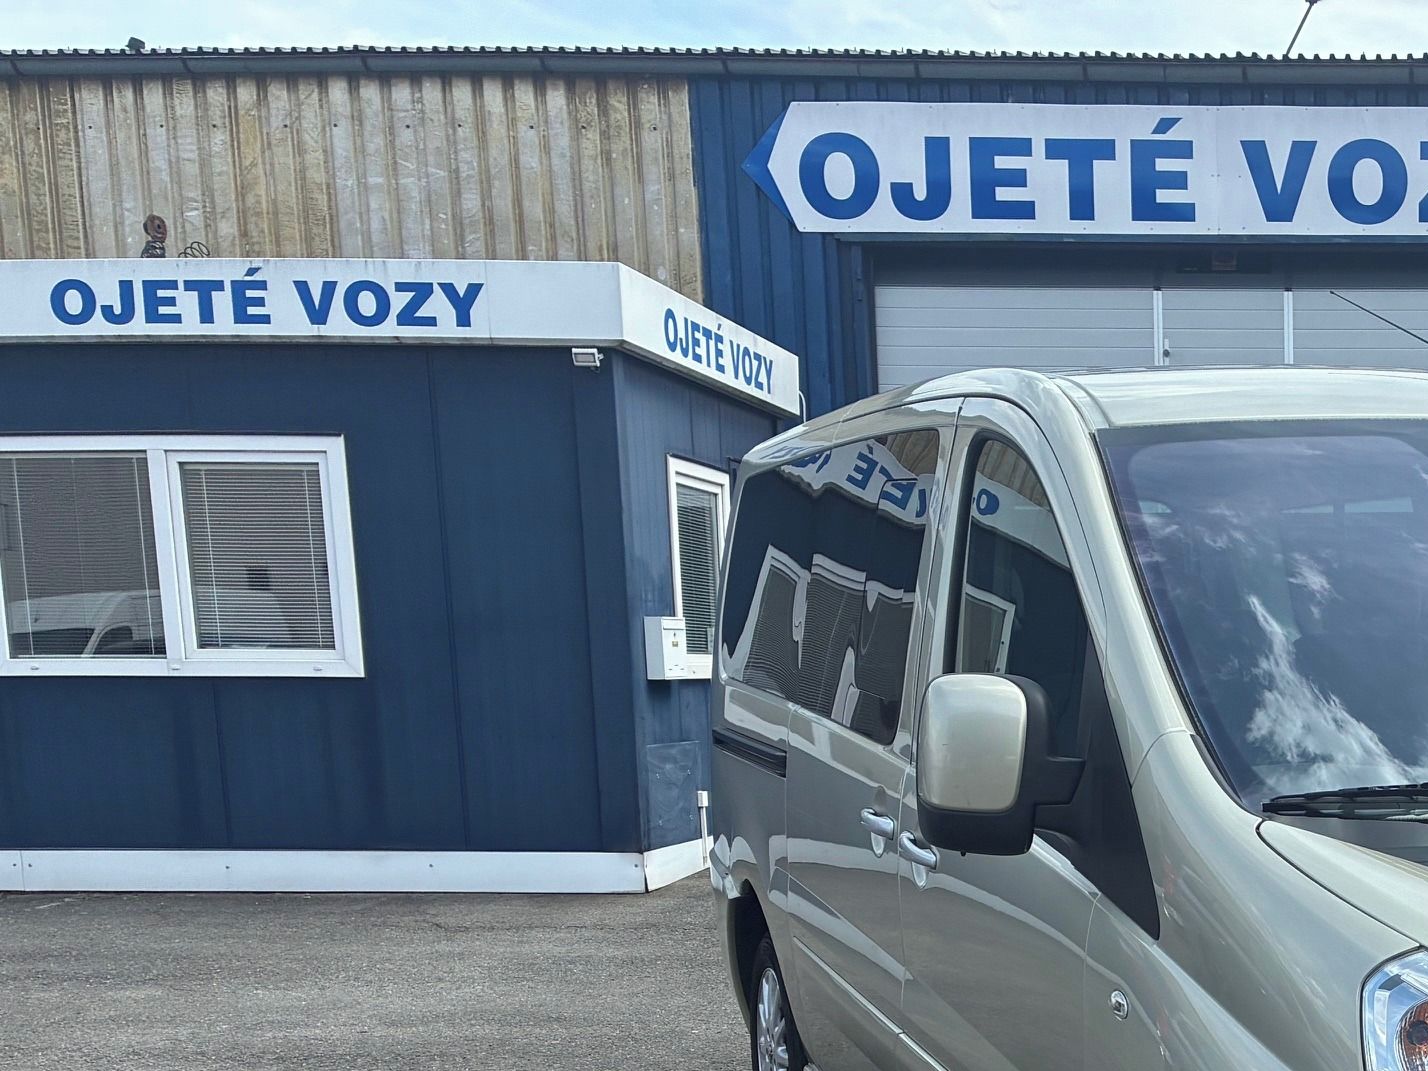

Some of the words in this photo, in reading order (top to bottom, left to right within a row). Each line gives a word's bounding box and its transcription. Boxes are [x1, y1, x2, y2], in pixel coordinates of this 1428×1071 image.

[799, 118, 1196, 223] OJETÉ
[50, 267, 272, 326] OJETÉ
[294, 280, 484, 328] VOZY
[664, 308, 726, 375] OJETÉ
[729, 339, 774, 395] VOZY
